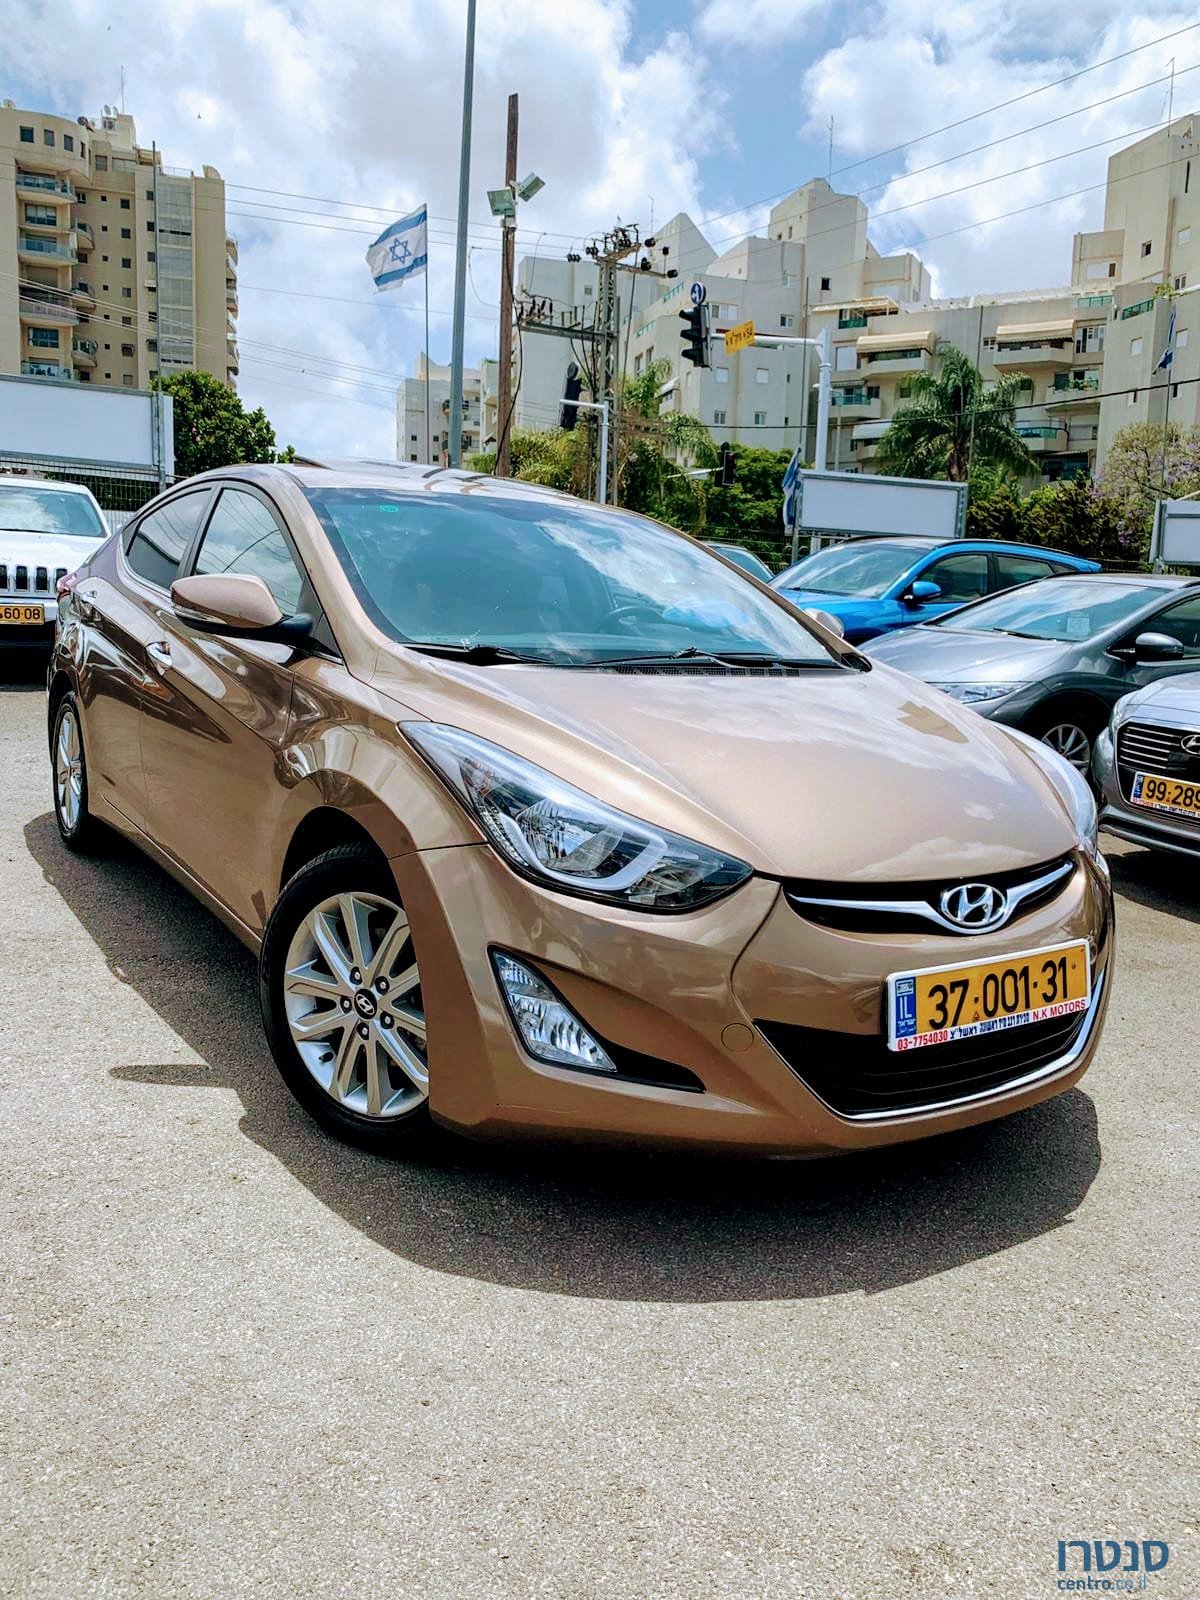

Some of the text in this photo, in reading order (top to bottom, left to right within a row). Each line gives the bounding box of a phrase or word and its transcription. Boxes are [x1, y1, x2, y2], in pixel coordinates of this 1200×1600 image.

[900, 996, 912, 1019] IL
[1033, 999, 1086, 1021] N.K MOTORS
[898, 1030, 948, 1050] 03-7754030
